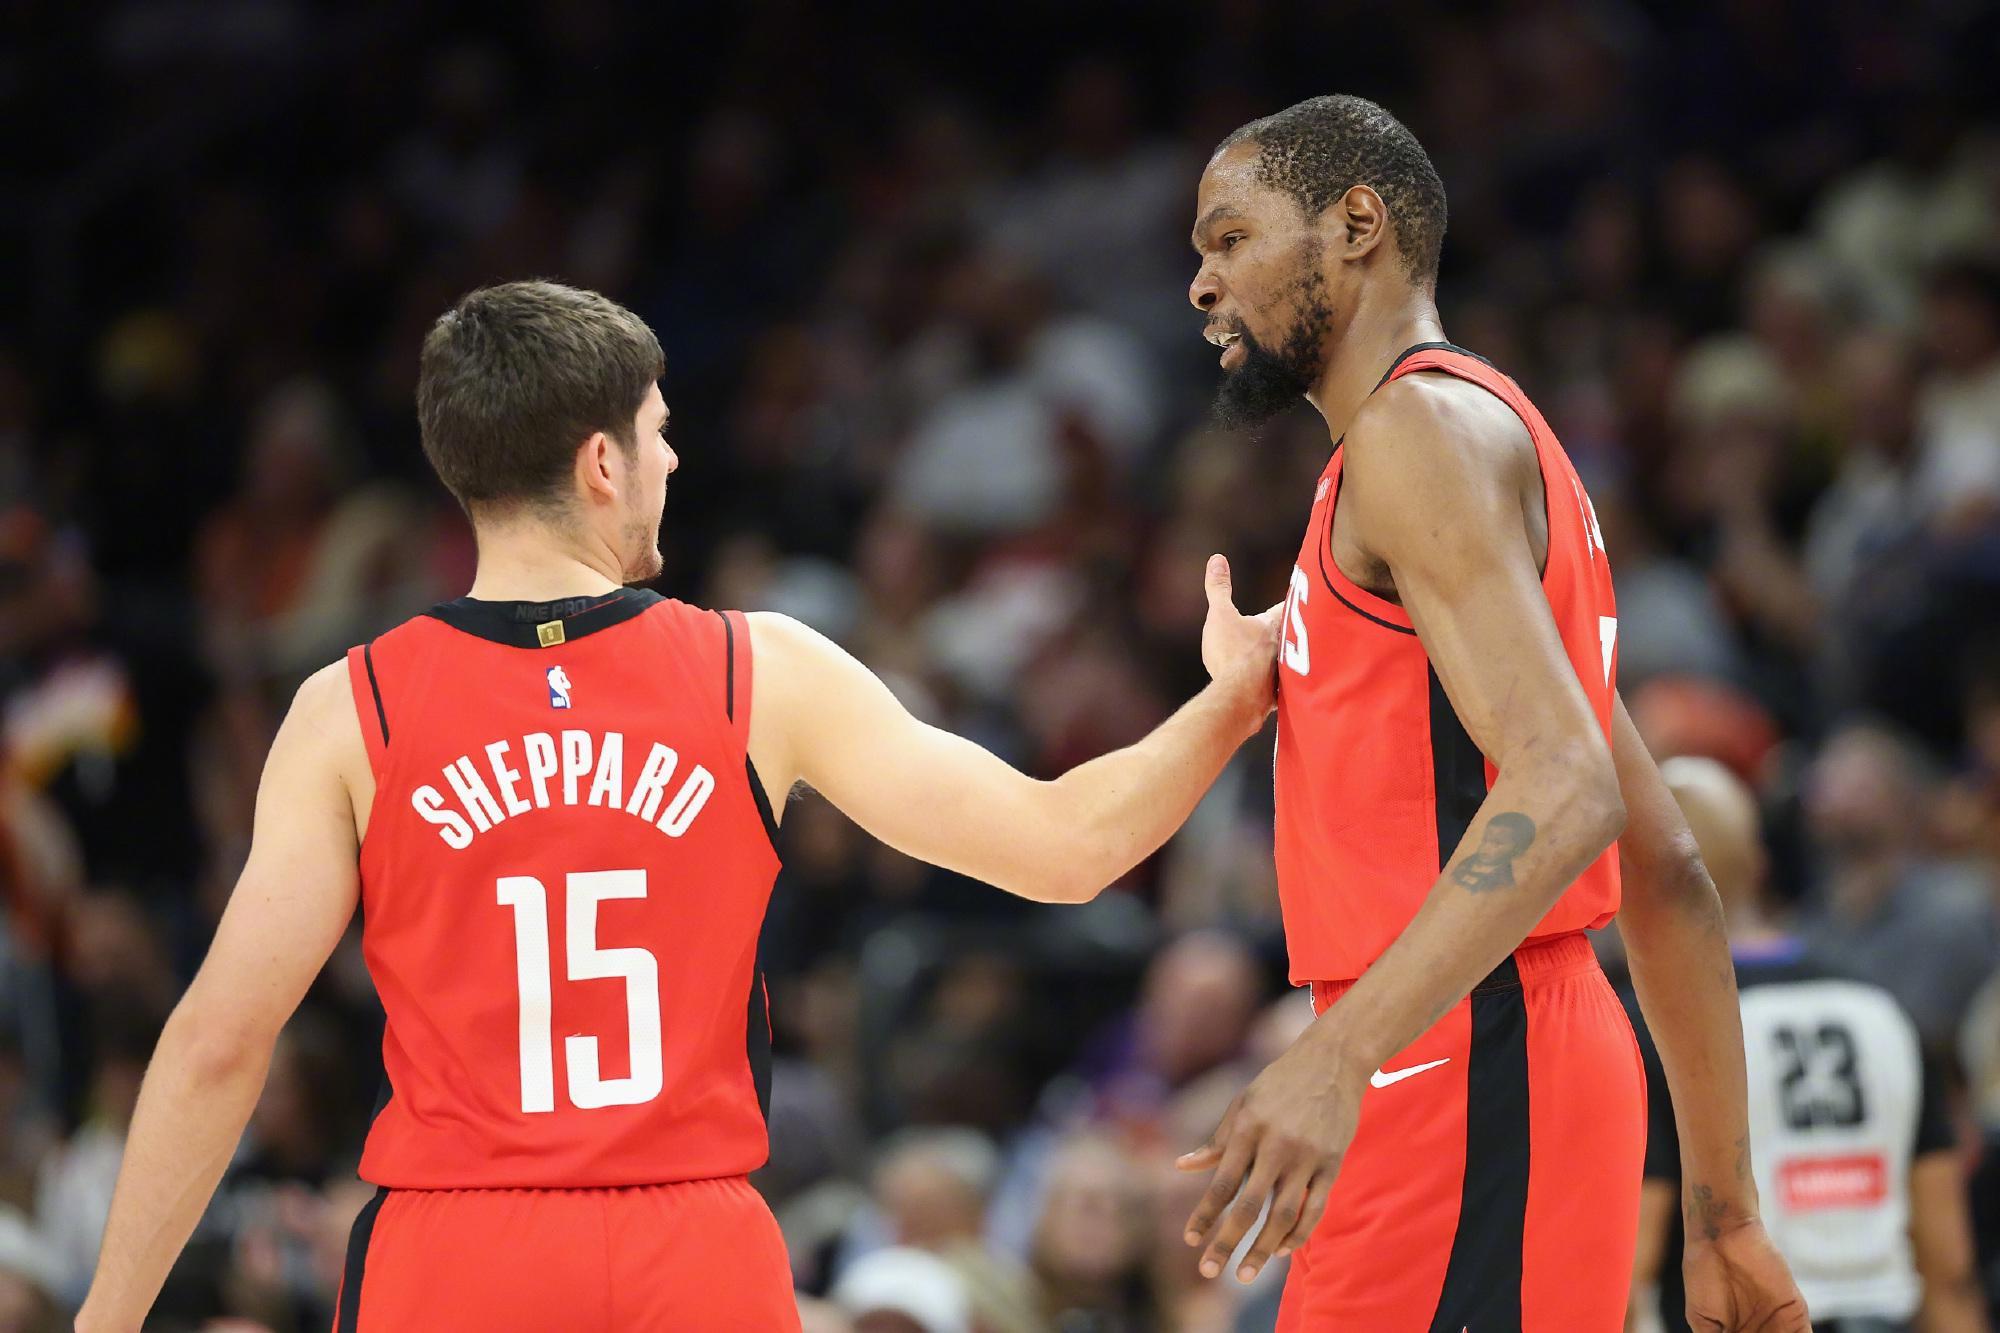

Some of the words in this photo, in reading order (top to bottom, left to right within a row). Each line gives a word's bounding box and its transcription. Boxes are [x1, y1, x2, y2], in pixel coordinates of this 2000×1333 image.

[411, 729, 716, 850] SHEPPARD
[496, 869, 664, 1113] 15
[1772, 1020, 1866, 1132] 23
